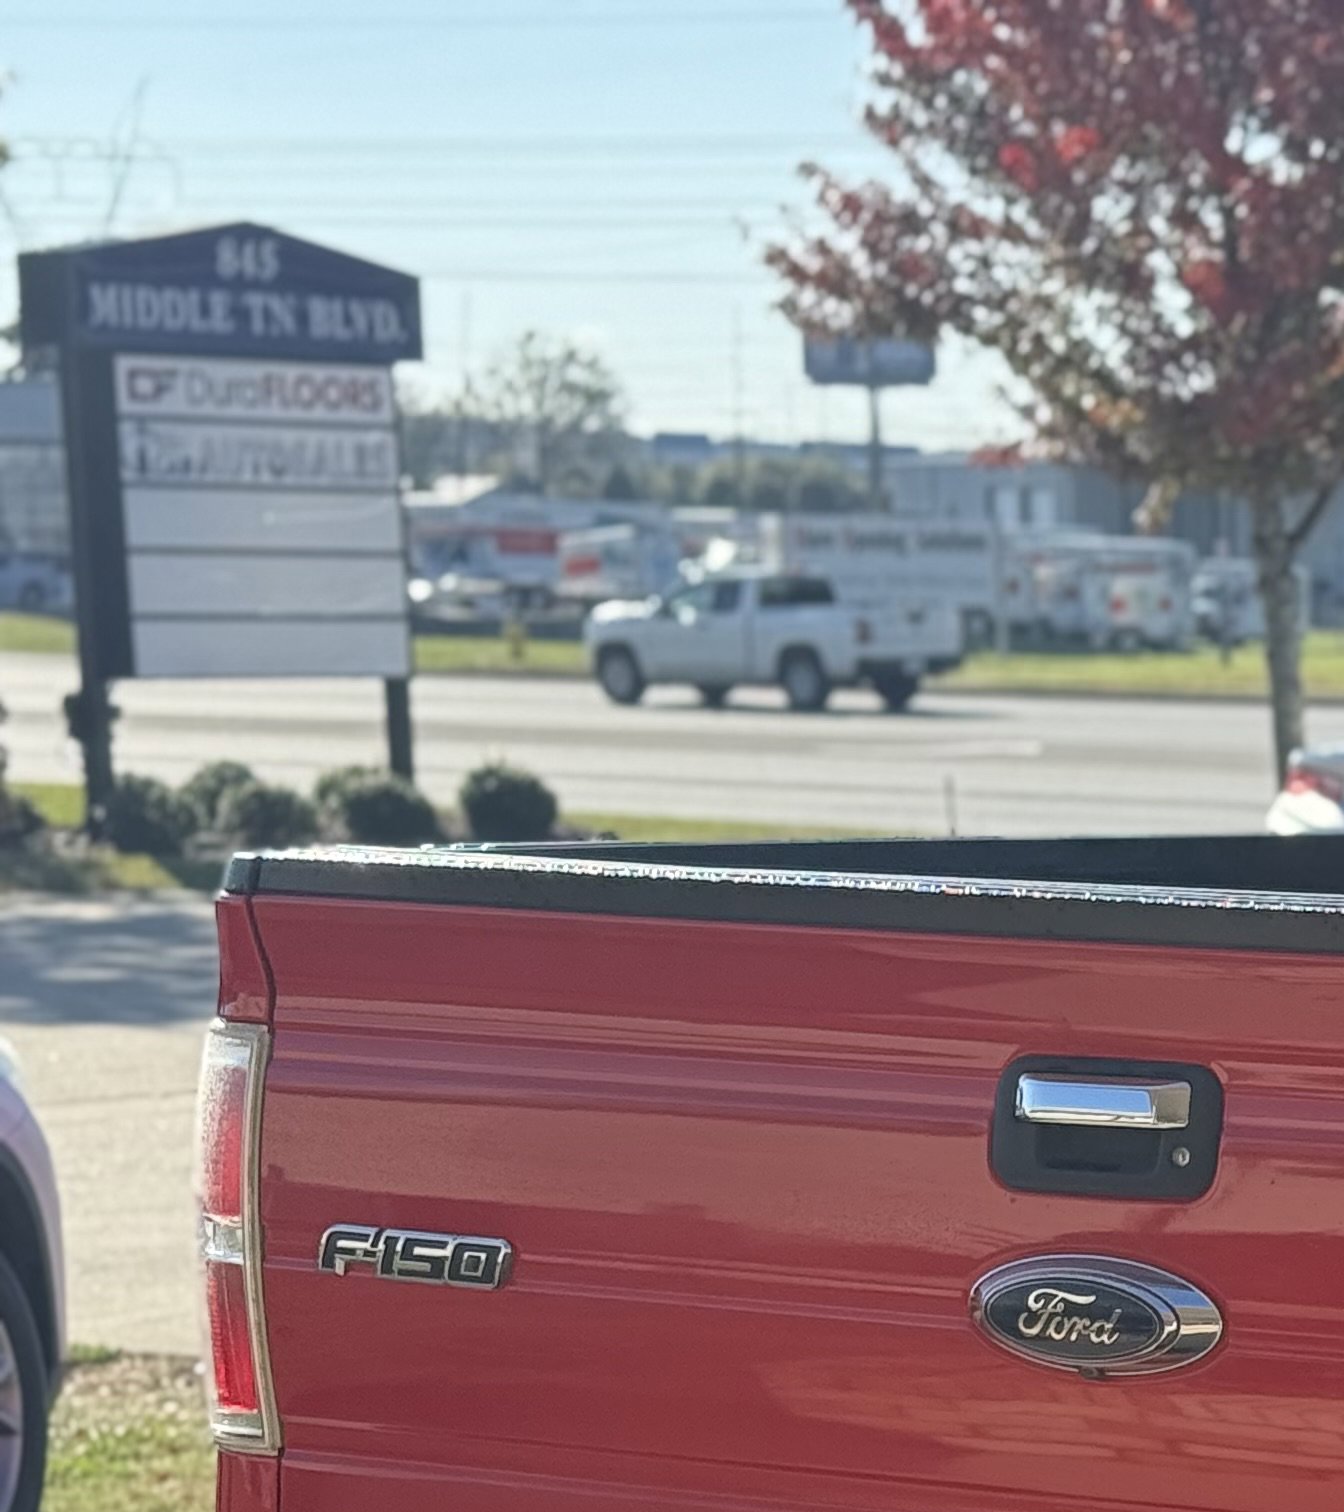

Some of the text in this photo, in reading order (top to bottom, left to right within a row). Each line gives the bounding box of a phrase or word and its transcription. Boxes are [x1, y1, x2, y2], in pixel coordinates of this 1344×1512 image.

[88, 282, 408, 342] MIDDLE TN BLVD.
[1017, 1288, 1122, 1345] Ford
